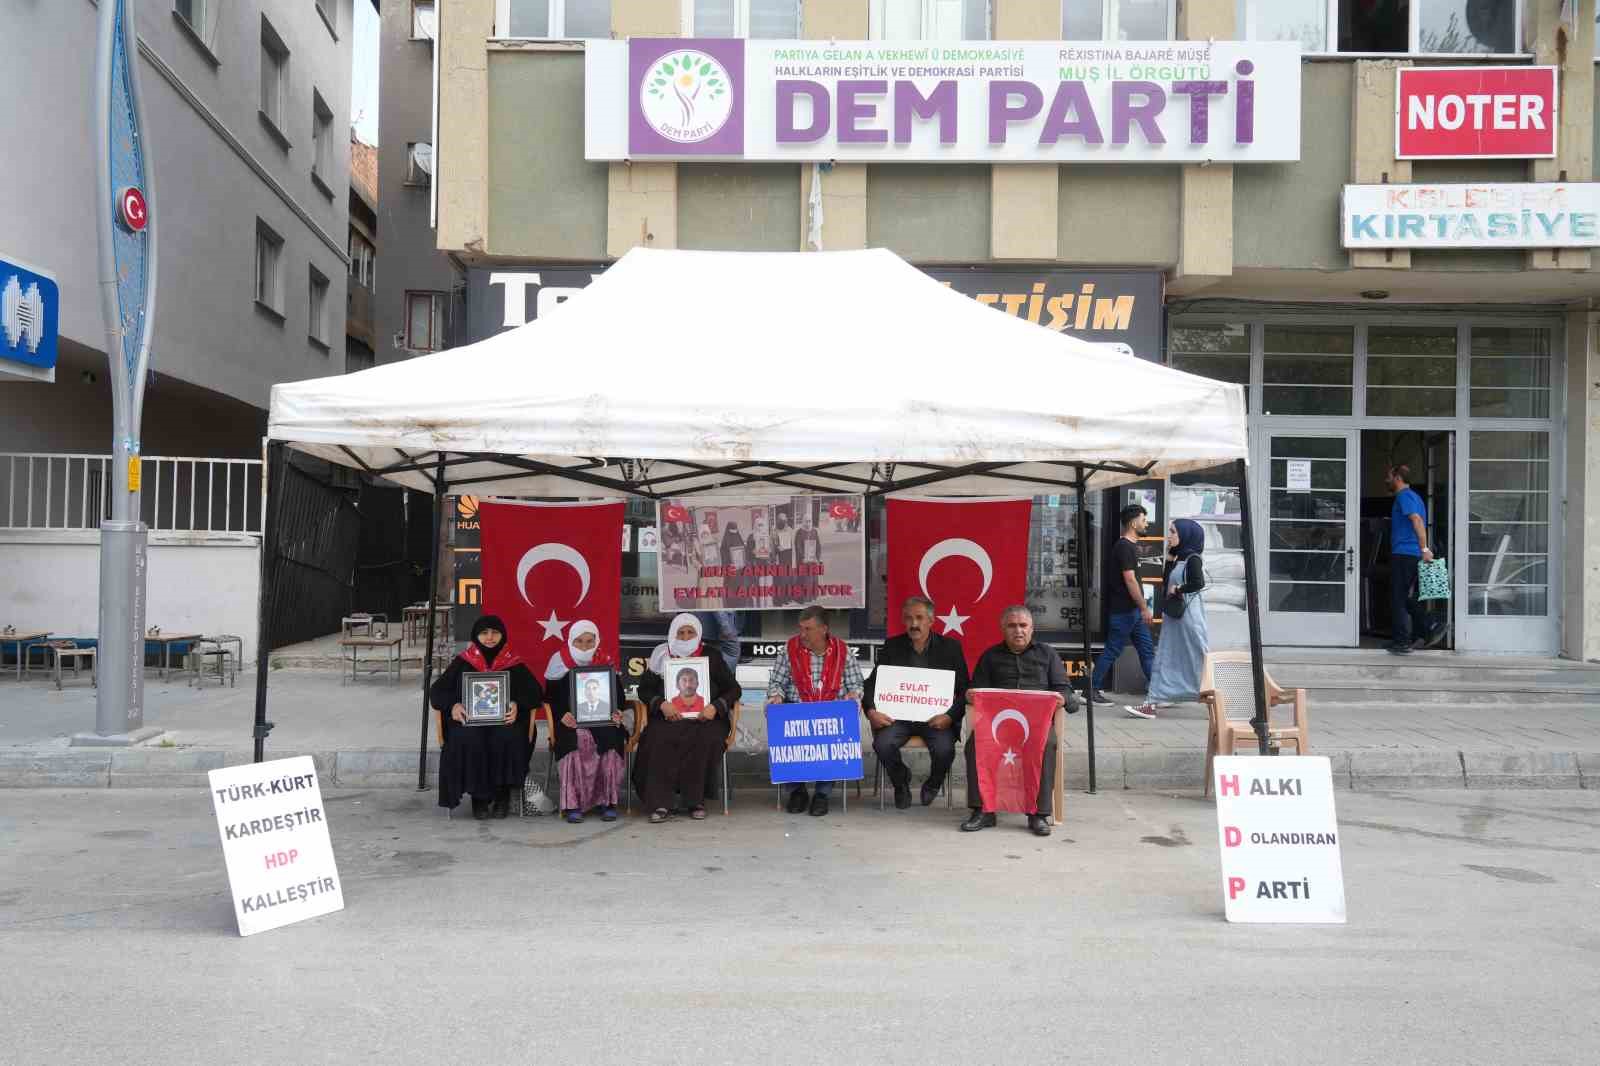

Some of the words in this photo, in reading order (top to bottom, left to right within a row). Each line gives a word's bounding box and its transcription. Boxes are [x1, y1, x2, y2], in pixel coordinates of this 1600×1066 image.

[822, 49, 863, 61] GELAN
[865, 49, 874, 61] A
[775, 66, 842, 77] HALKLARIN
[844, 64, 888, 78] EŞİTLİK
[891, 66, 906, 77] VE
[908, 64, 975, 77] DEMOKRASİ
[979, 64, 1025, 77] PARTİSİ
[1059, 66, 1099, 82] MUŞ
[1107, 64, 1124, 80] İL
[1130, 64, 1211, 80] ÖRGÜTÜ
[776, 80, 957, 144] DEM
[988, 59, 1254, 144] PARTİ
[1407, 94, 1546, 130] NOTER
[660, 122, 681, 138] DEM
[683, 121, 714, 138] PARTİ
[1351, 209, 1597, 240] KIRTASİYE
[899, 682, 928, 692] EVLAT
[878, 692, 950, 707] NÖBETİNDEYİZ
[784, 719, 810, 737] ARTIK
[812, 718, 839, 736] YETER
[769, 744, 829, 764] YAKAMIZDAN
[831, 738, 862, 765] DÜŞÜN
[216, 774, 314, 804] TÜRK-KÜRT
[1220, 774, 1240, 796] H
[1250, 778, 1302, 796] ALKI
[225, 806, 323, 840] KARDEŞTİR
[1224, 826, 1242, 848] D
[1251, 832, 1337, 845] OLANDIRAN
[264, 848, 299, 870] HDP
[241, 876, 336, 914] KALLEŞTİR
[1228, 876, 1246, 900] P
[1256, 876, 1311, 900] ARTİ
